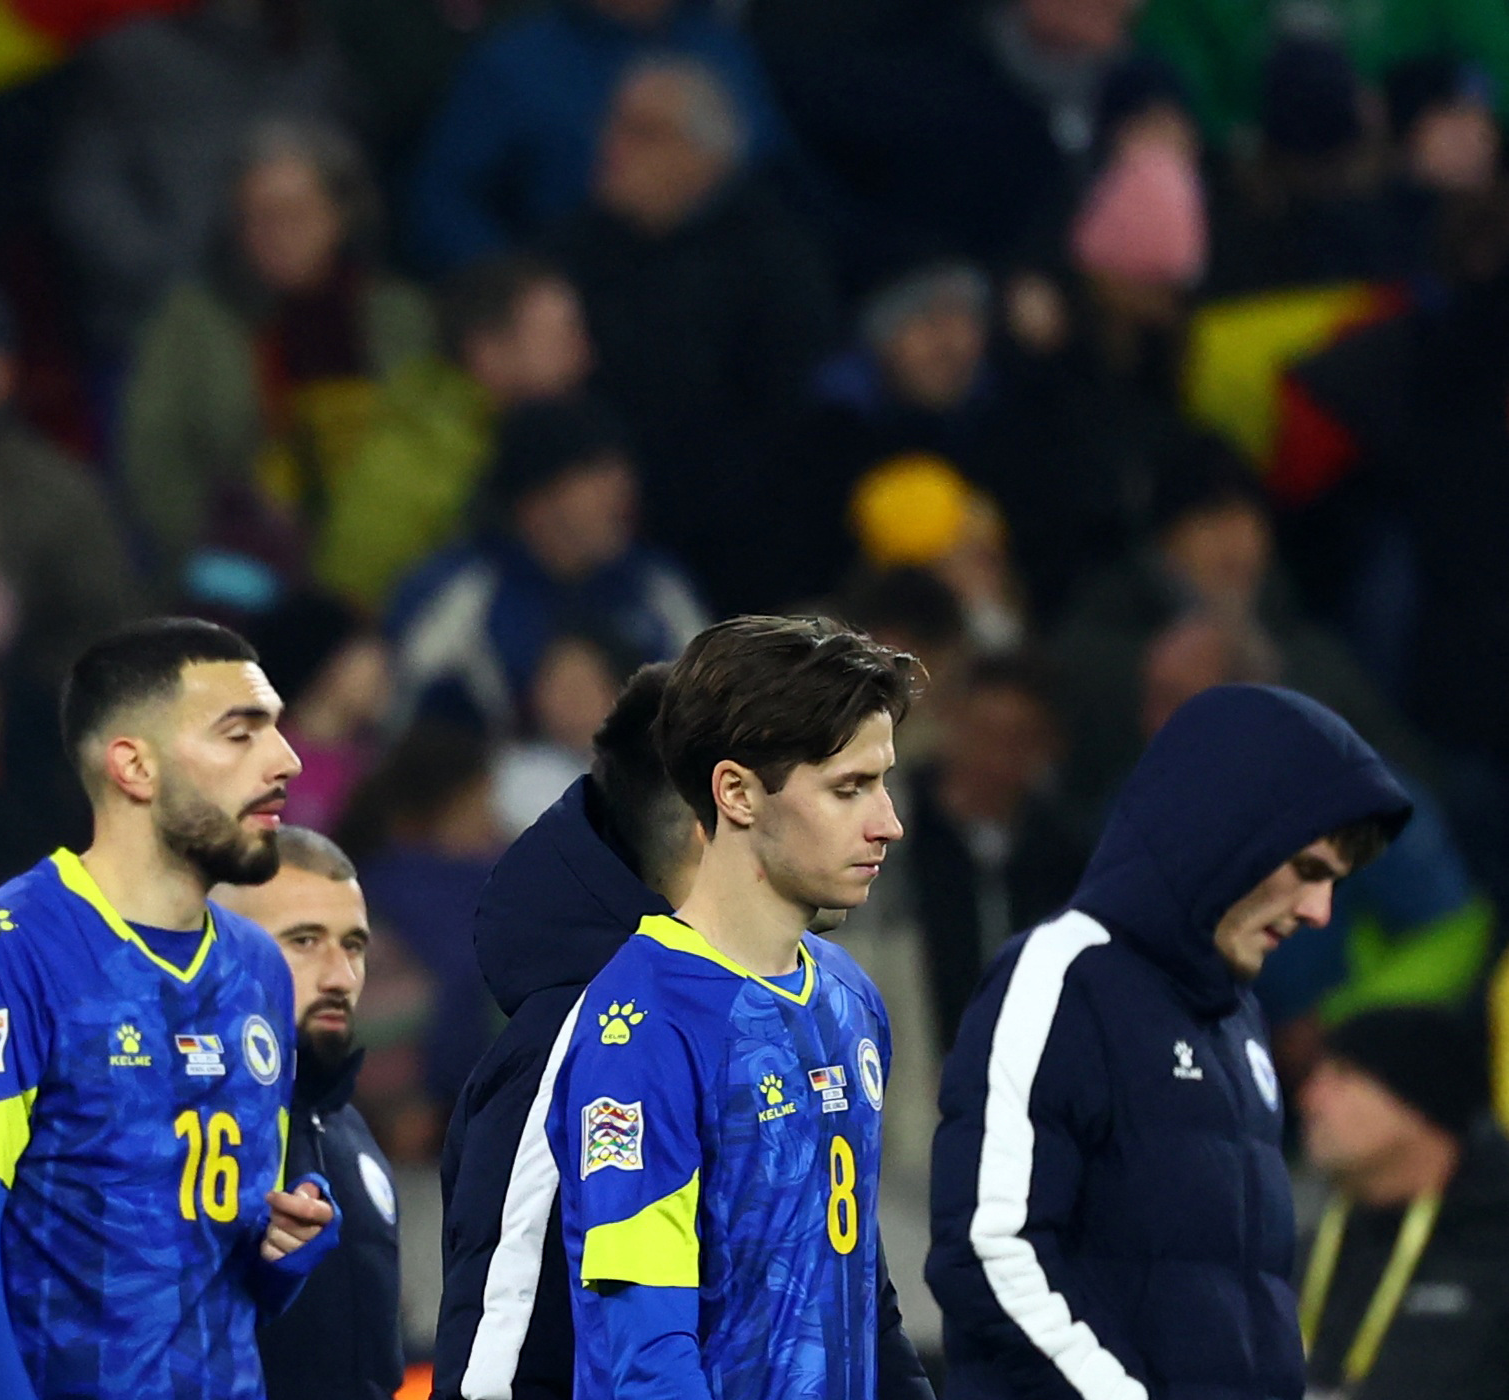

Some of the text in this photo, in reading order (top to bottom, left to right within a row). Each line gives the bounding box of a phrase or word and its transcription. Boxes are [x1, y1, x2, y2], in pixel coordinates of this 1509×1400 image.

[109, 1055, 152, 1066] KELME
[758, 1101, 797, 1123] KELME
[174, 1110, 242, 1223] 16
[826, 1134, 858, 1255] 8
